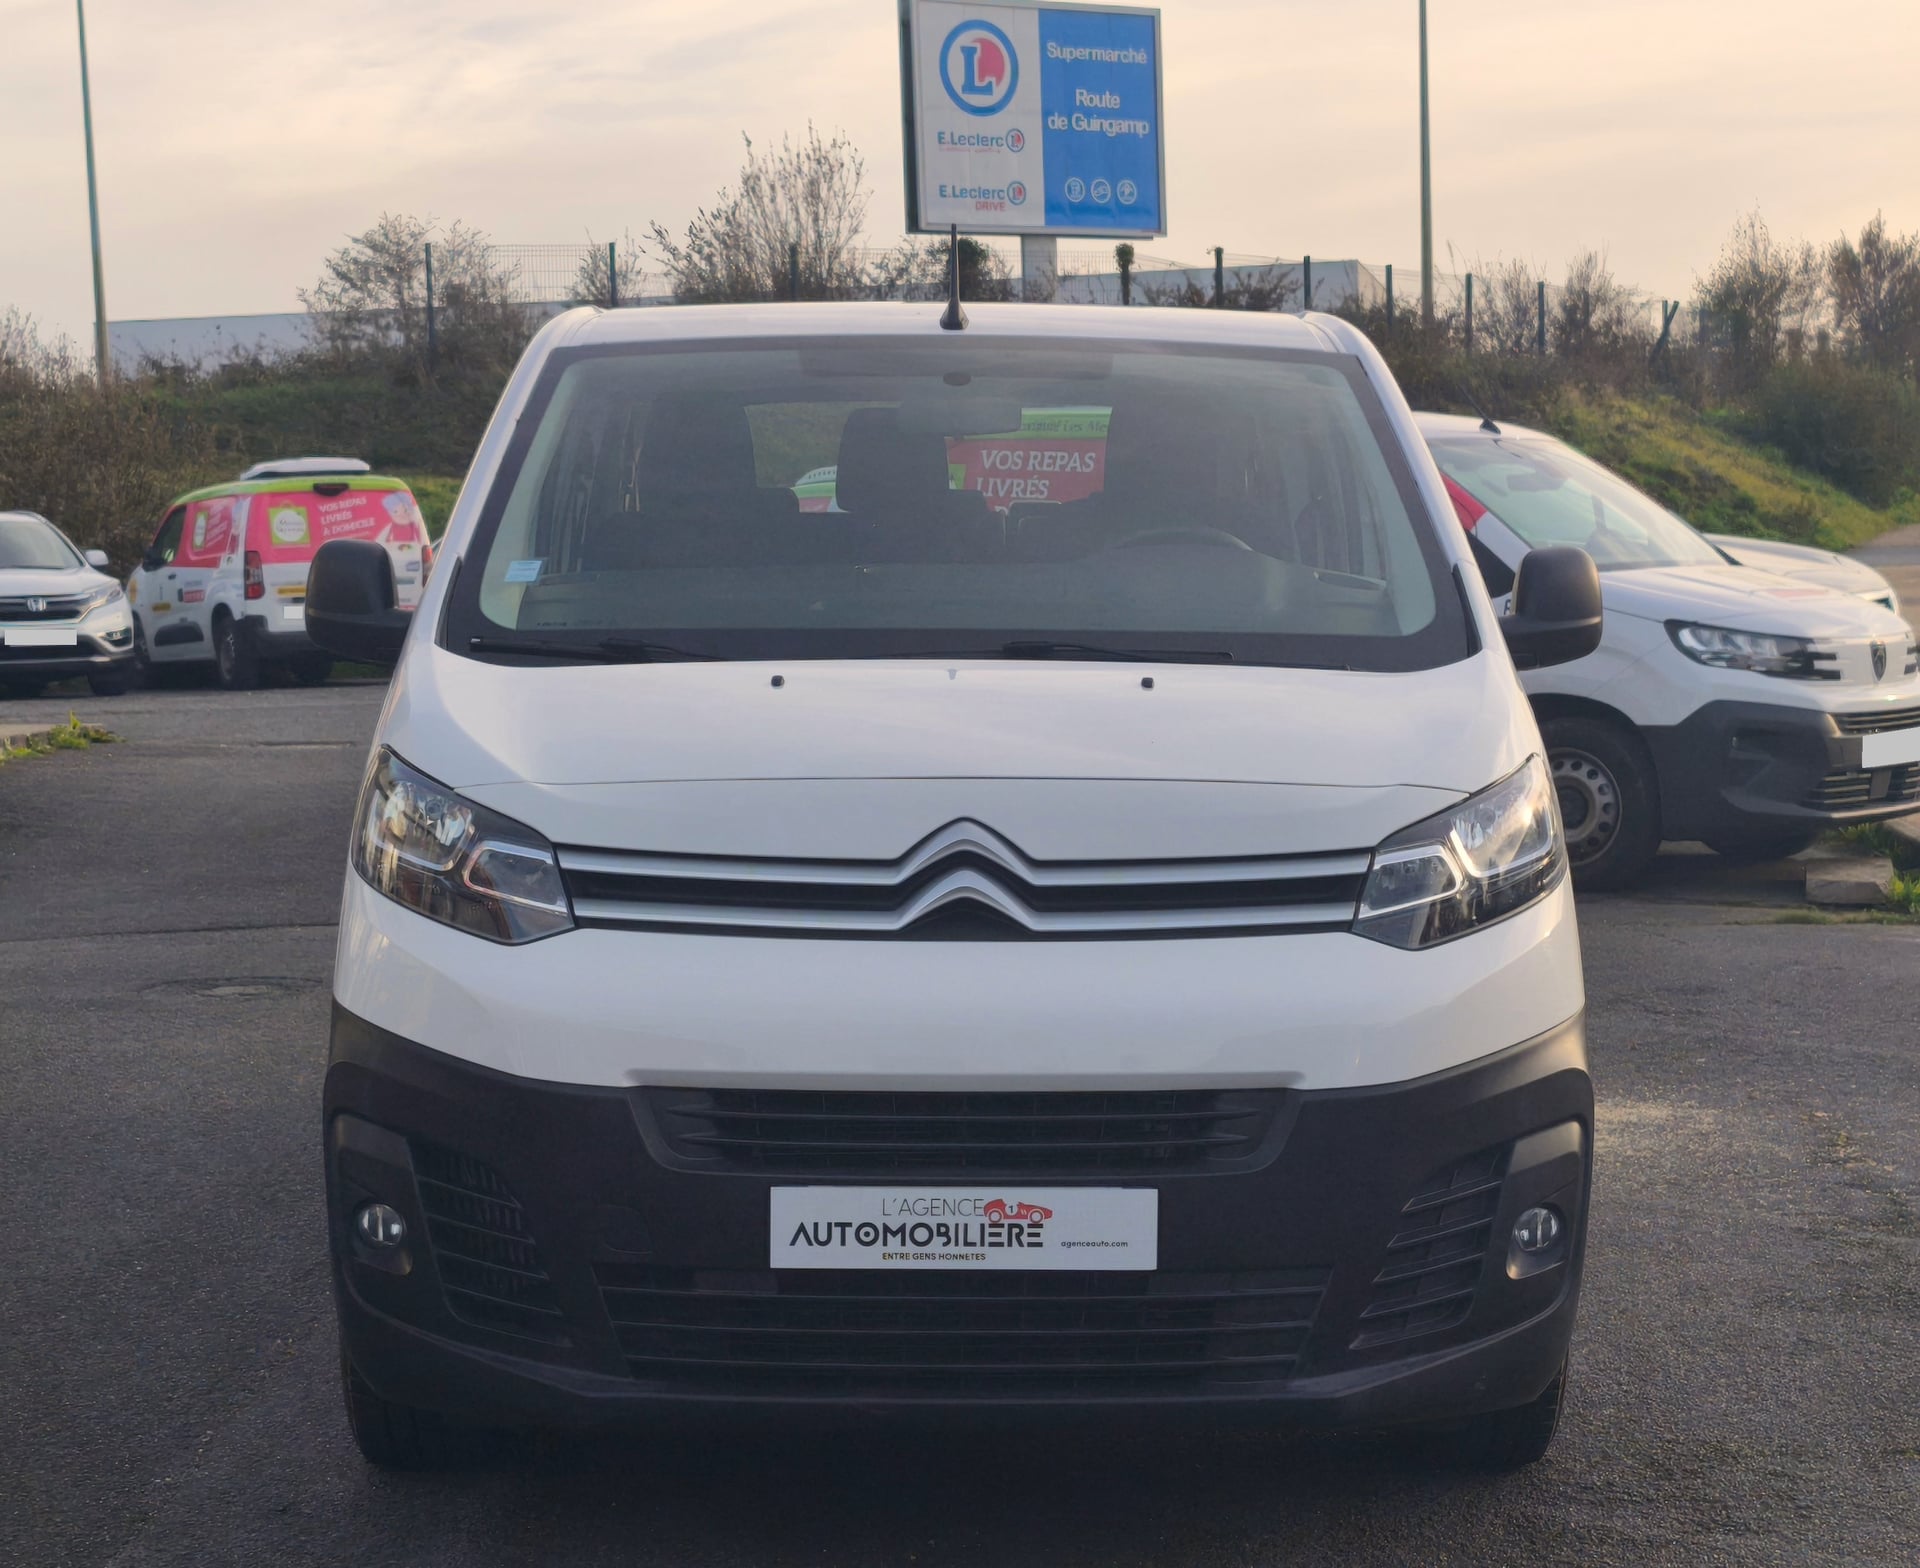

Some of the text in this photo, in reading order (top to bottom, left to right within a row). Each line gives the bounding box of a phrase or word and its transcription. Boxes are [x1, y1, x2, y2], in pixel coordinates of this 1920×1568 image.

[1047, 41, 1148, 64] Supermarché
[1075, 88, 1121, 109] Route
[1047, 112, 1150, 138] de Guingamp
[937, 131, 1004, 148] E.Leclerc
[938, 184, 1006, 201] E.Leclerc
[975, 200, 1007, 212] DRIVE
[980, 449, 1097, 473] VOS REPAS
[976, 474, 1050, 499] LIVRÉS
[882, 1197, 984, 1217] L'AGENCE
[1060, 1239, 1129, 1249] agenceauto.com
[882, 1252, 911, 1261] ENTRE
[912, 1252, 936, 1261] GENS
